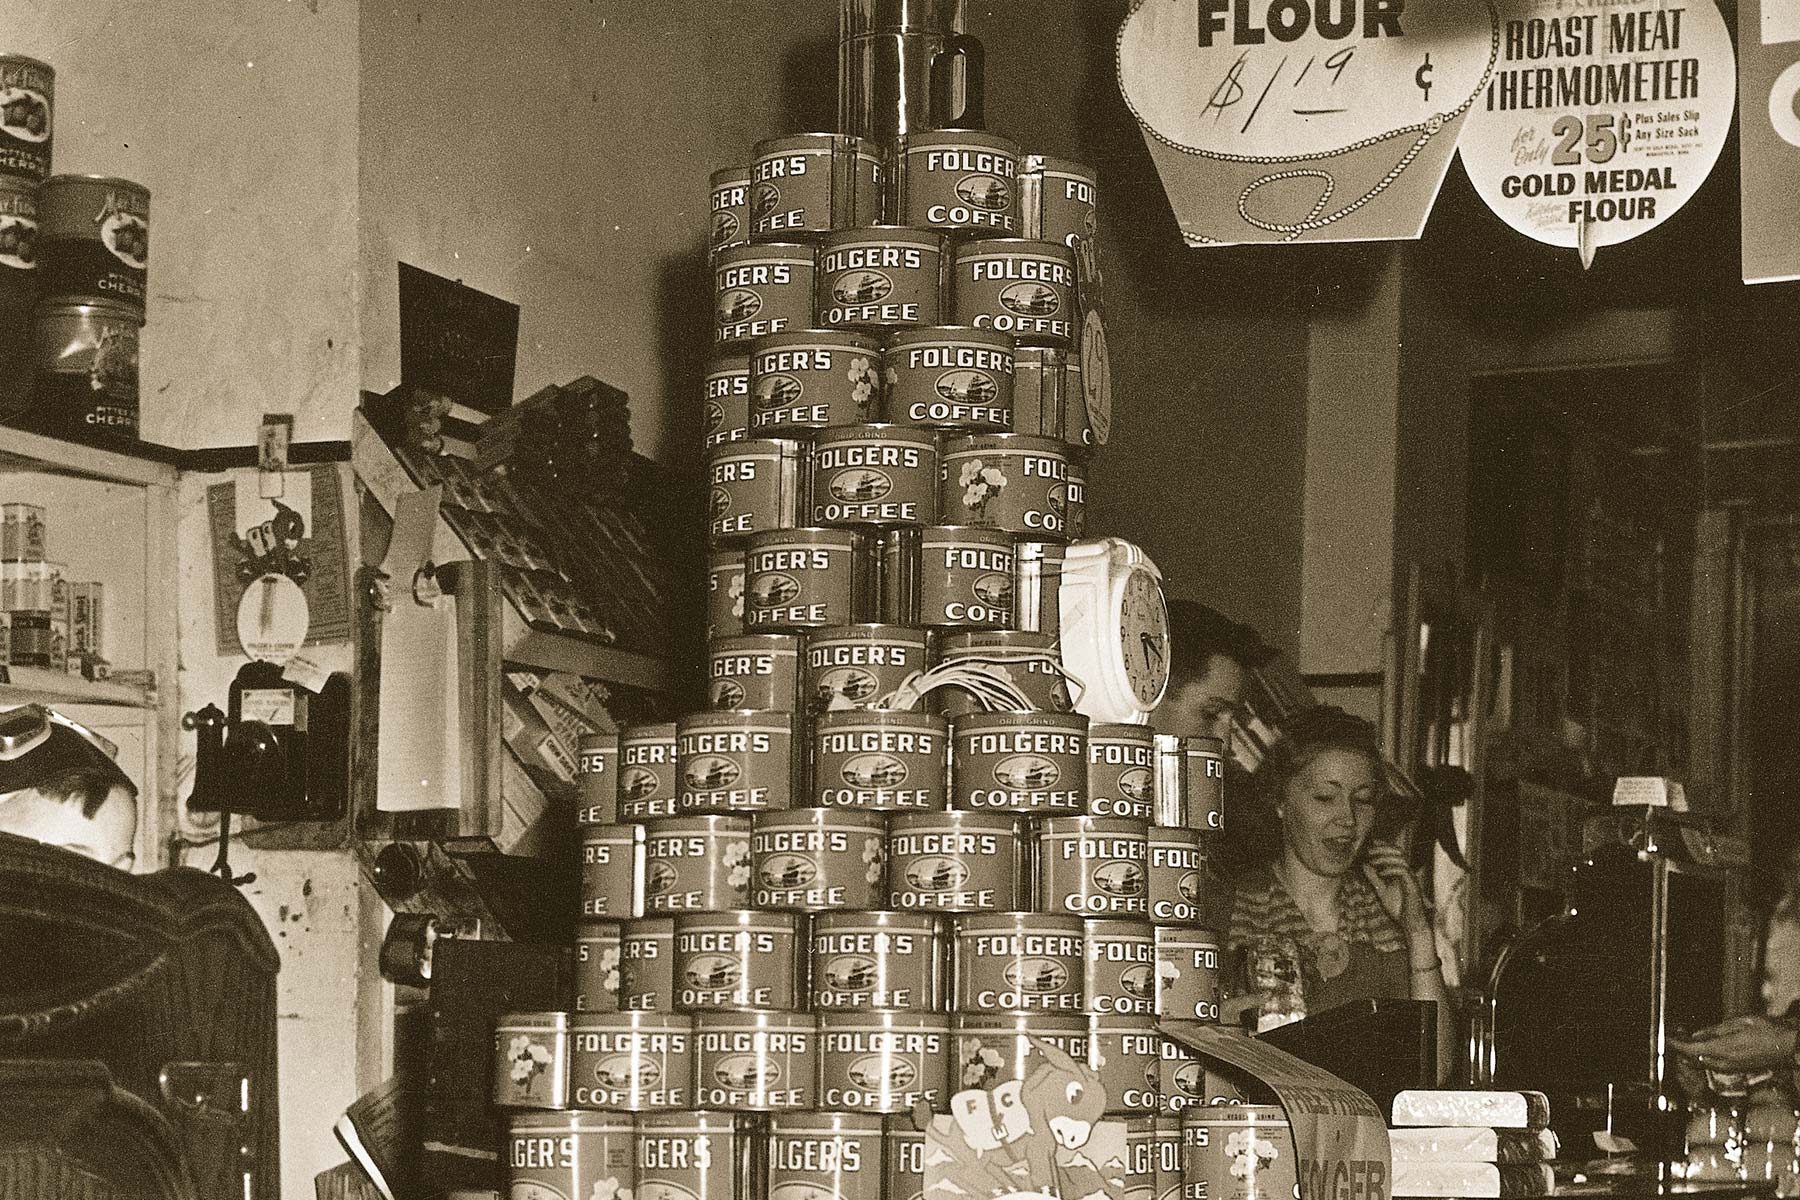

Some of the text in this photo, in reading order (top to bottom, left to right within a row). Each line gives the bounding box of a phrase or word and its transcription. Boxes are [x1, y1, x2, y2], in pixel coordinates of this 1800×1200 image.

[1199, 0, 1404, 47] FLOUR
[1506, 8, 1685, 60] ROAST MEAT
[1635, 111, 1700, 125] Plus Sales Slip
[1635, 127, 1699, 142] Any Size Sack
[1502, 167, 1676, 198] GOLD MEDAL
[1569, 197, 1656, 223] FLOUR
[973, 262, 1073, 286] FOLGER'S
[973, 314, 1072, 338] COFFEE
[909, 349, 1013, 375] FOLGER'S
[909, 402, 1010, 426] COFFEE
[814, 504, 916, 521] COFFEE
[822, 732, 932, 756] FOLGER'S
[969, 735, 1080, 755] FOLGER'S
[822, 788, 931, 806] COFFEE
[970, 789, 1079, 808] COFFEE
[891, 890, 994, 908] COFFEE
[976, 936, 1083, 956] FOLGER'S
[577, 1034, 685, 1053] FOLGER'S
[827, 1034, 940, 1053] FOLGER'S
[577, 1088, 683, 1105] COFFEE
